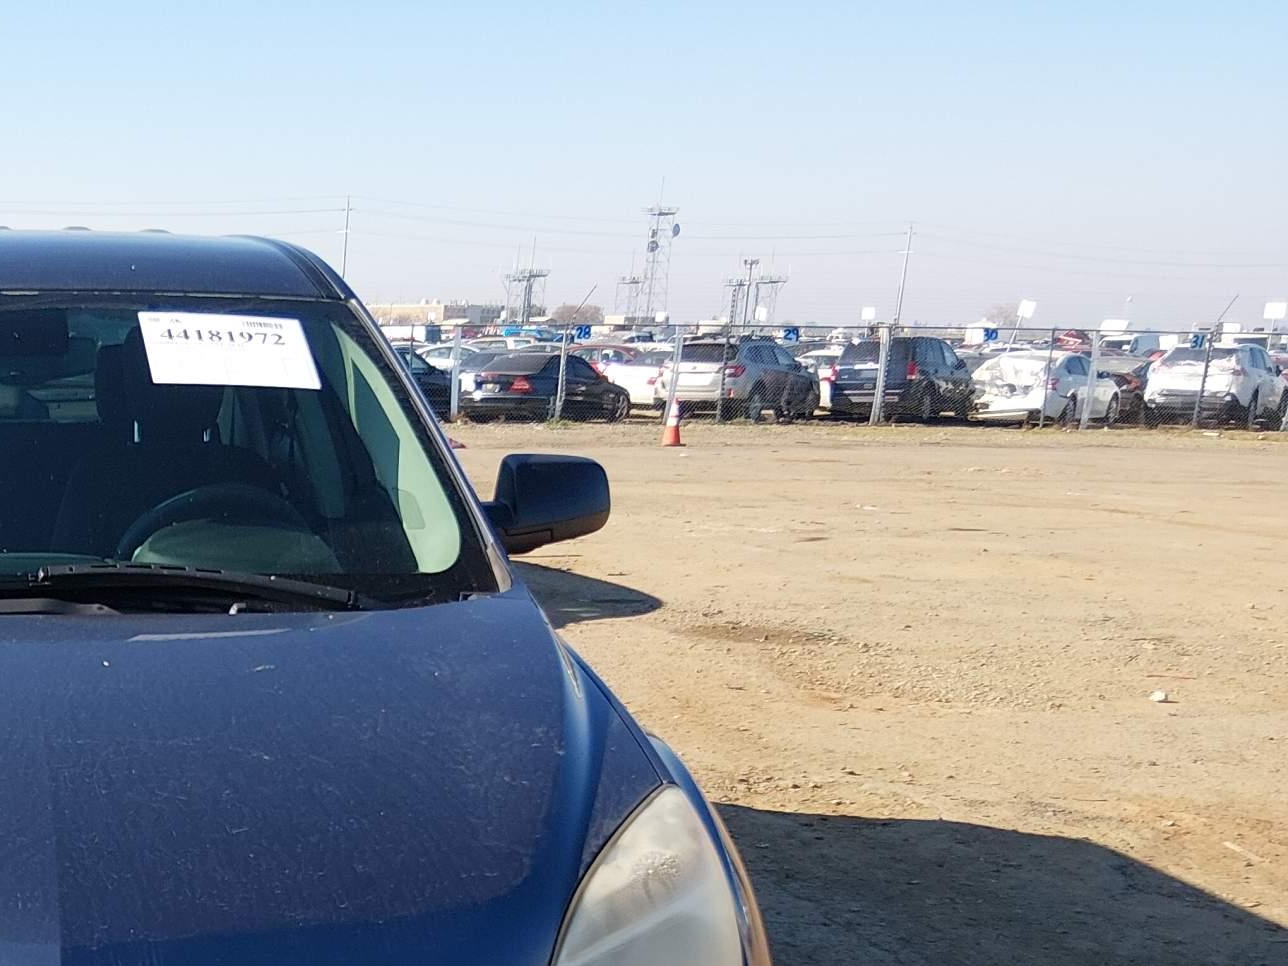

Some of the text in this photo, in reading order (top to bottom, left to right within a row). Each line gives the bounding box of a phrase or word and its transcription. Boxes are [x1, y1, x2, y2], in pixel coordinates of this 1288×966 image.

[159, 328, 286, 346] 44181972
[575, 325, 591, 340] 28
[783, 327, 799, 341] 29
[983, 328, 998, 342] 30
[1191, 334, 1205, 348] 31
